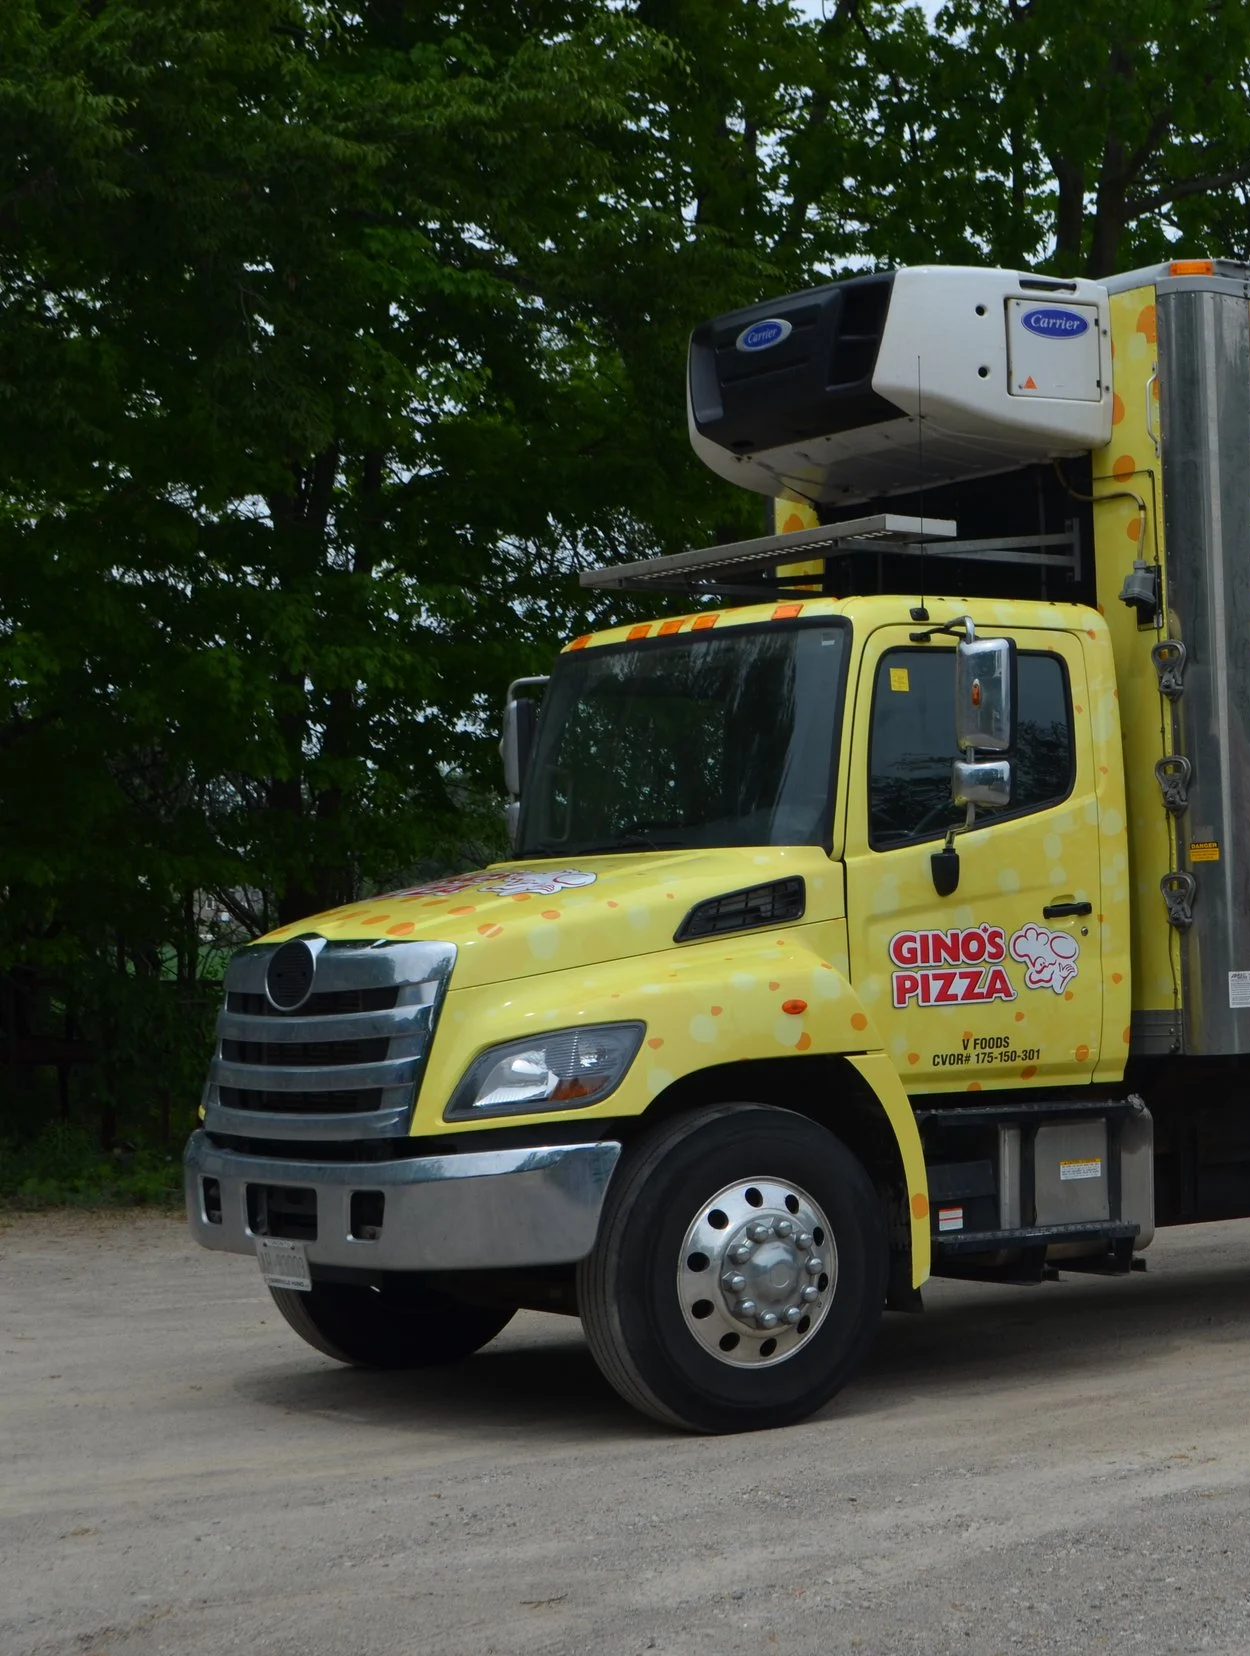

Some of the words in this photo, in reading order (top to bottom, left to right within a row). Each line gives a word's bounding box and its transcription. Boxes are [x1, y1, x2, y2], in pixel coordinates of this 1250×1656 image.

[1031, 313, 1080, 330] Carrier
[747, 328, 777, 345] Carrier
[892, 925, 1005, 965] GINO'S
[895, 969, 1014, 1005] PIZZA
[961, 1038, 970, 1050] V
[973, 1036, 1010, 1050] FOODS
[932, 1052, 971, 1067] CVOR#
[975, 1049, 1041, 1065] 175-150-301
